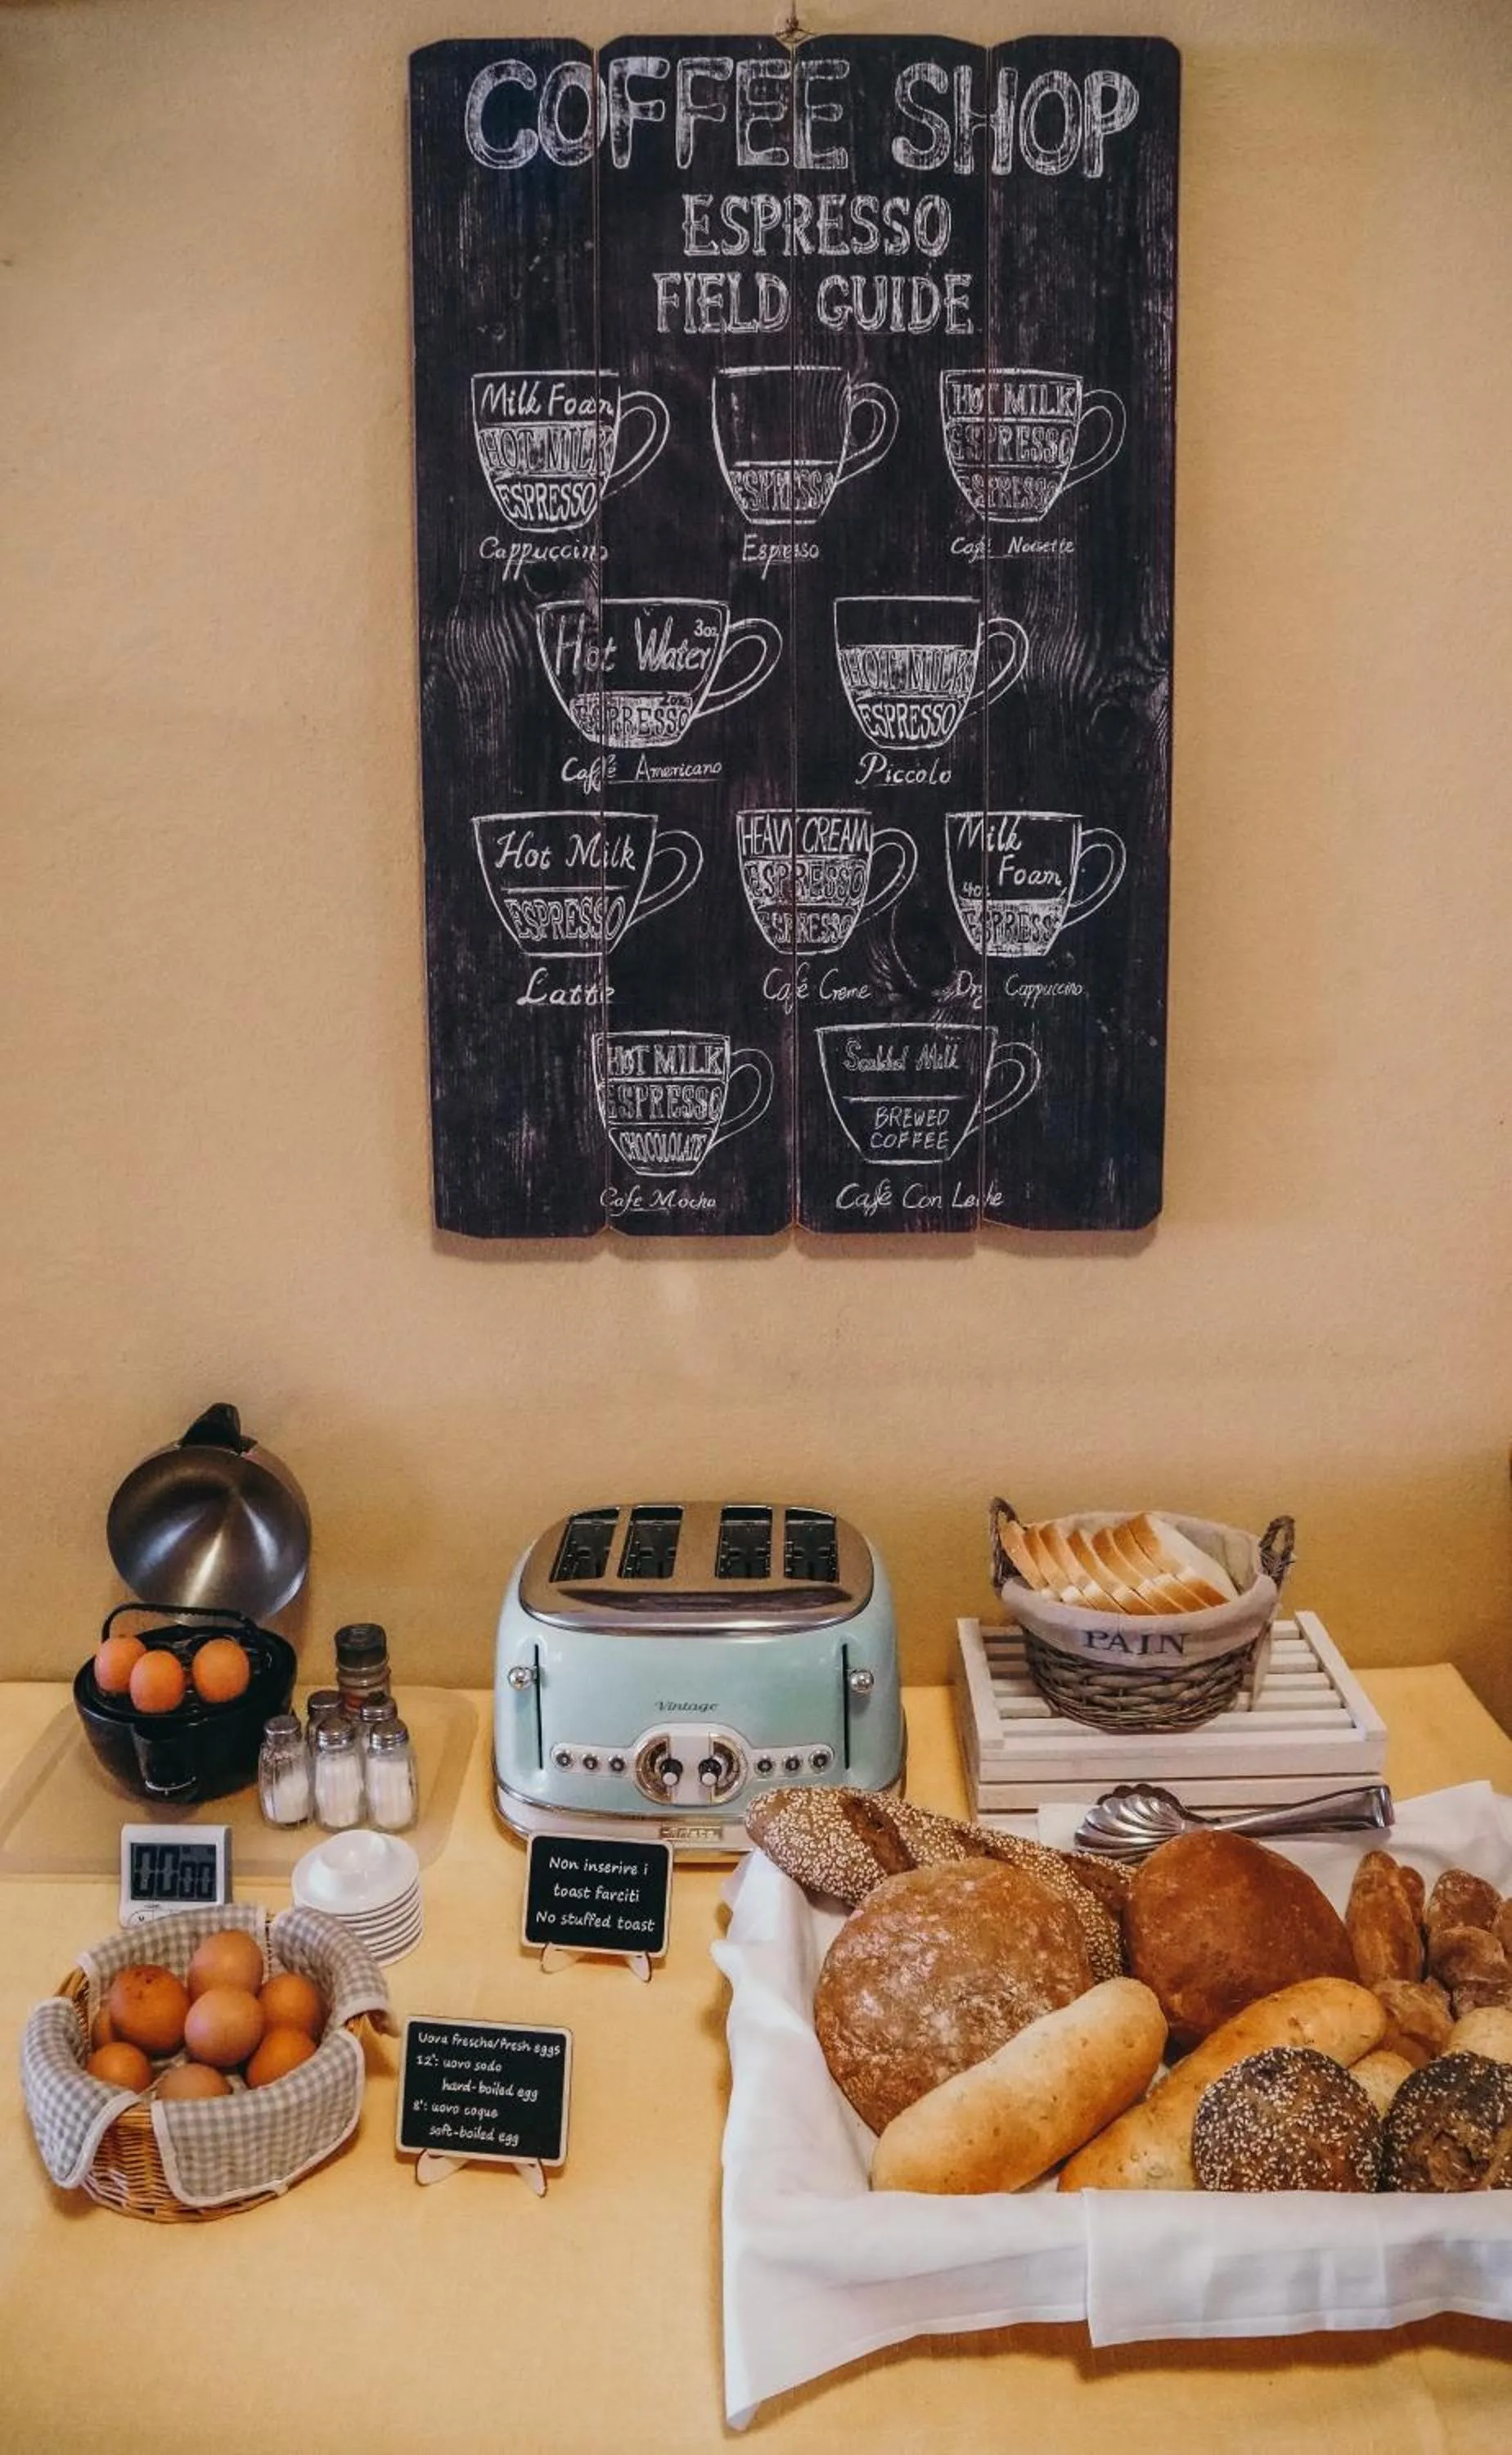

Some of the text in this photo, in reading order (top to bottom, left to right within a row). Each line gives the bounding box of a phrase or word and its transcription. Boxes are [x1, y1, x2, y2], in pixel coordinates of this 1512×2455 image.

[465, 56, 1140, 179] COFFEE SHOP
[682, 193, 952, 257] ESPRESSO
[653, 273, 974, 336] FIELD GUIDE
[480, 380, 542, 417] Milk
[952, 382, 1077, 417] HOT MILK
[478, 426, 615, 472] HOT MILK
[947, 423, 1075, 465] ESPRESSO
[496, 481, 596, 522] ESPRESSO
[728, 468, 835, 512] ESPRESSO
[955, 474, 1061, 509] ESPRESSO
[479, 536, 608, 582] Cappuccino
[742, 533, 819, 580] Espresso
[556, 612, 711, 676] Hot Water
[839, 649, 897, 691] HOT
[575, 705, 691, 737] ESPRESSO
[858, 702, 957, 740] ESPRESSO
[634, 752, 722, 782] Americano
[854, 752, 952, 786] Piccolo
[494, 831, 637, 871] Hot Milk
[803, 816, 870, 854] CREAM
[956, 817, 1023, 852] Milk
[745, 861, 866, 899] ESPRESSO
[999, 854, 1062, 887] Foam
[504, 896, 626, 941] ESPRESSO
[758, 912, 855, 944] ESPRESSO
[605, 1044, 725, 1076] HOT MILK
[604, 1084, 723, 1122] ESPRESSO
[875, 1106, 951, 1129] BREWED
[870, 1131, 951, 1151] COFFEE
[649, 1189, 718, 1209] Mocha
[835, 1178, 894, 1217] Café
[902, 1183, 942, 1209] Con
[1082, 1629, 1190, 1655] PAIN
[655, 1701, 720, 1713] Vintage
[549, 1856, 649, 1876] Non inserire i
[554, 1883, 641, 1903] toast farciti
[536, 1911, 655, 1932] No stuffed toast
[418, 2031, 449, 2045] Uova
[533, 2045, 561, 2058] eggs
[443, 2059, 470, 2070] uovo
[474, 2061, 502, 2073] sodo
[442, 2078, 538, 2102] hard-boiled egg
[431, 2104, 461, 2115] uovo
[429, 2124, 520, 2147] soft-boiled egg
